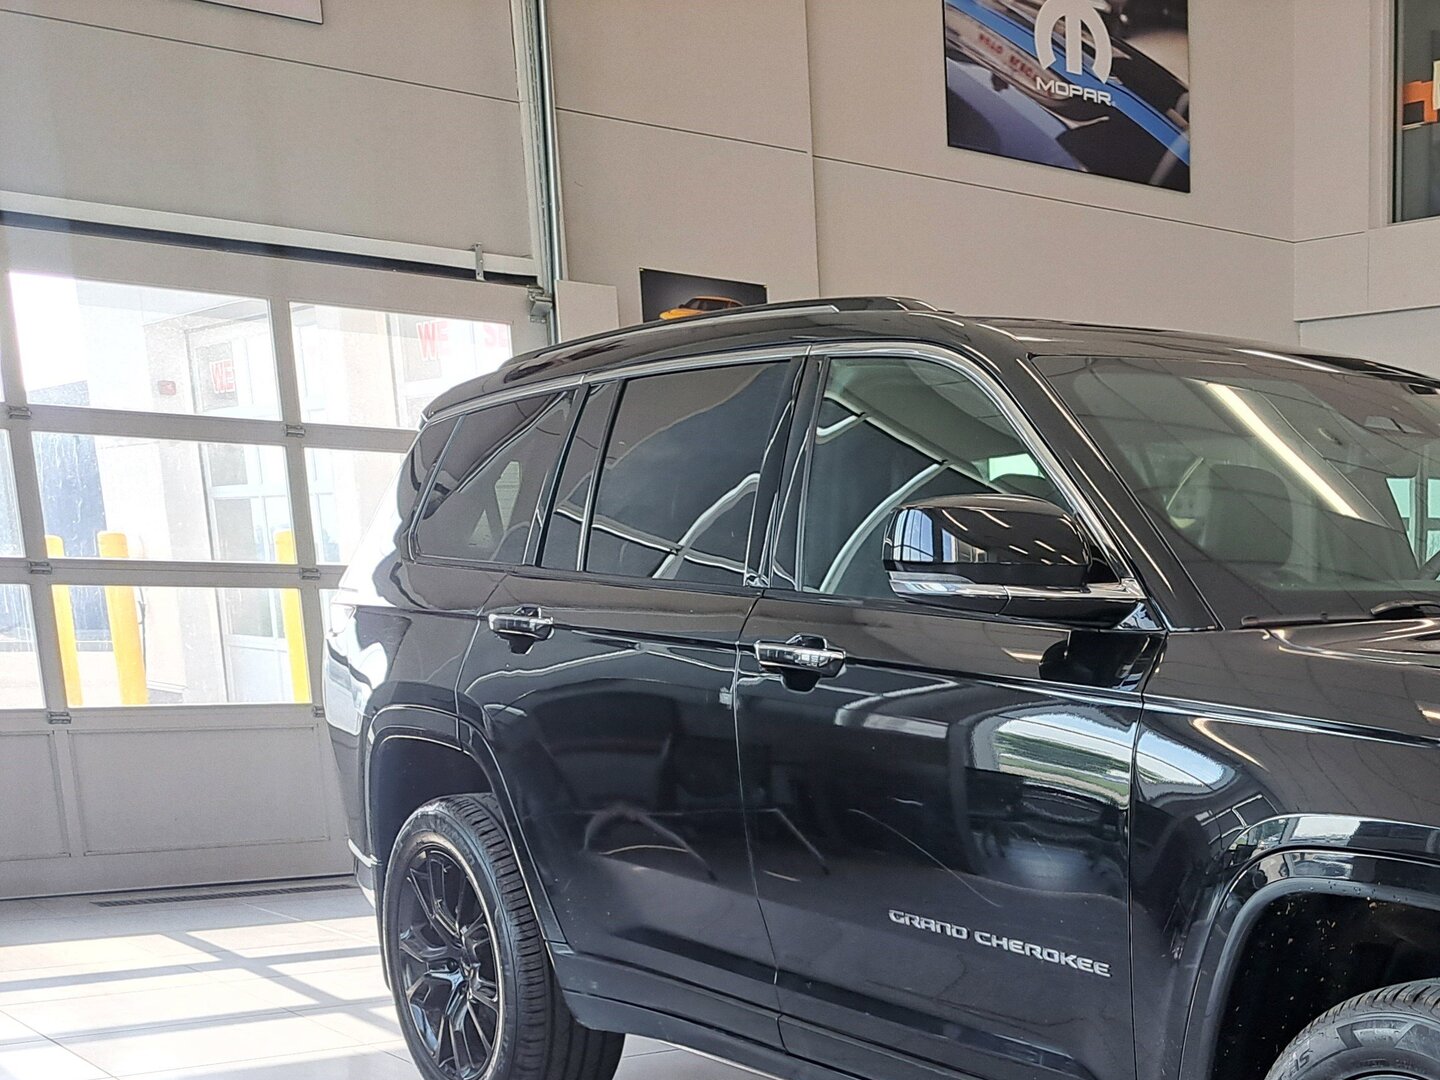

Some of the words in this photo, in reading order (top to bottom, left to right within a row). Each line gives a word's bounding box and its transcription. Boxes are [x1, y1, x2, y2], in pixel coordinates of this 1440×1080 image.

[1035, 76, 1113, 106] MOPAR
[888, 909, 970, 940] GRAND
[974, 930, 1112, 977] CHEROKEE
